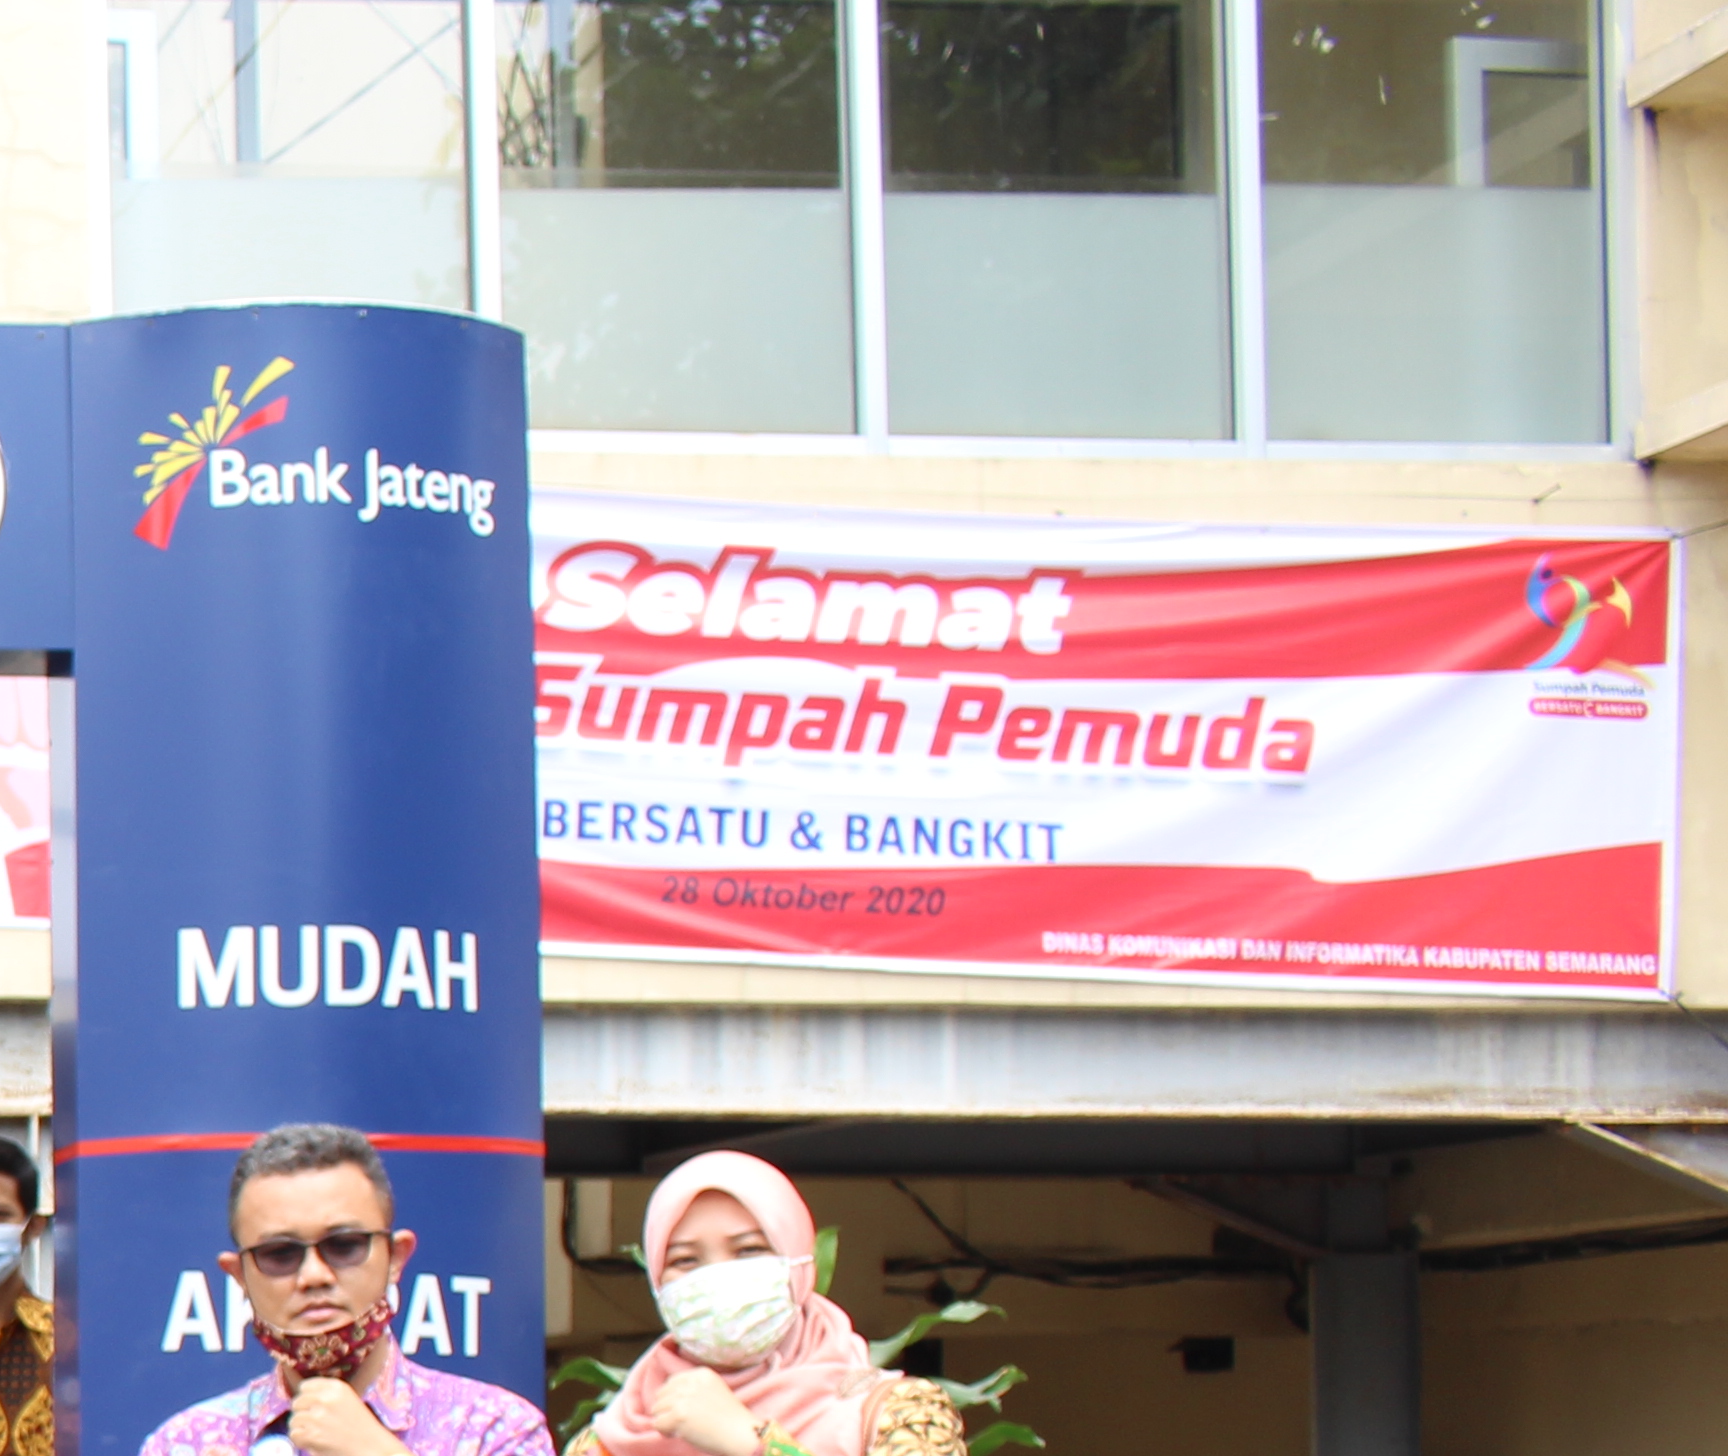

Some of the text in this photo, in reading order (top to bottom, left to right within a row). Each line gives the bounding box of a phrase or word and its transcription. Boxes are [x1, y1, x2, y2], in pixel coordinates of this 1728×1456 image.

[208, 445, 496, 536] Bank Jateng
[542, 541, 1074, 654] Selamat
[534, 664, 1314, 773] Sumpah Pemuda
[541, 799, 1066, 864] BERSATU & BANGKIT
[661, 872, 946, 916] 28 Oktober 2020
[176, 924, 478, 1013] MUDAH
[1043, 932, 1657, 976] DINAS KOMUNIKASI DAN INFORMATIKA KABUPATEN SEMARANG
[161, 1270, 492, 1357] AKAT
